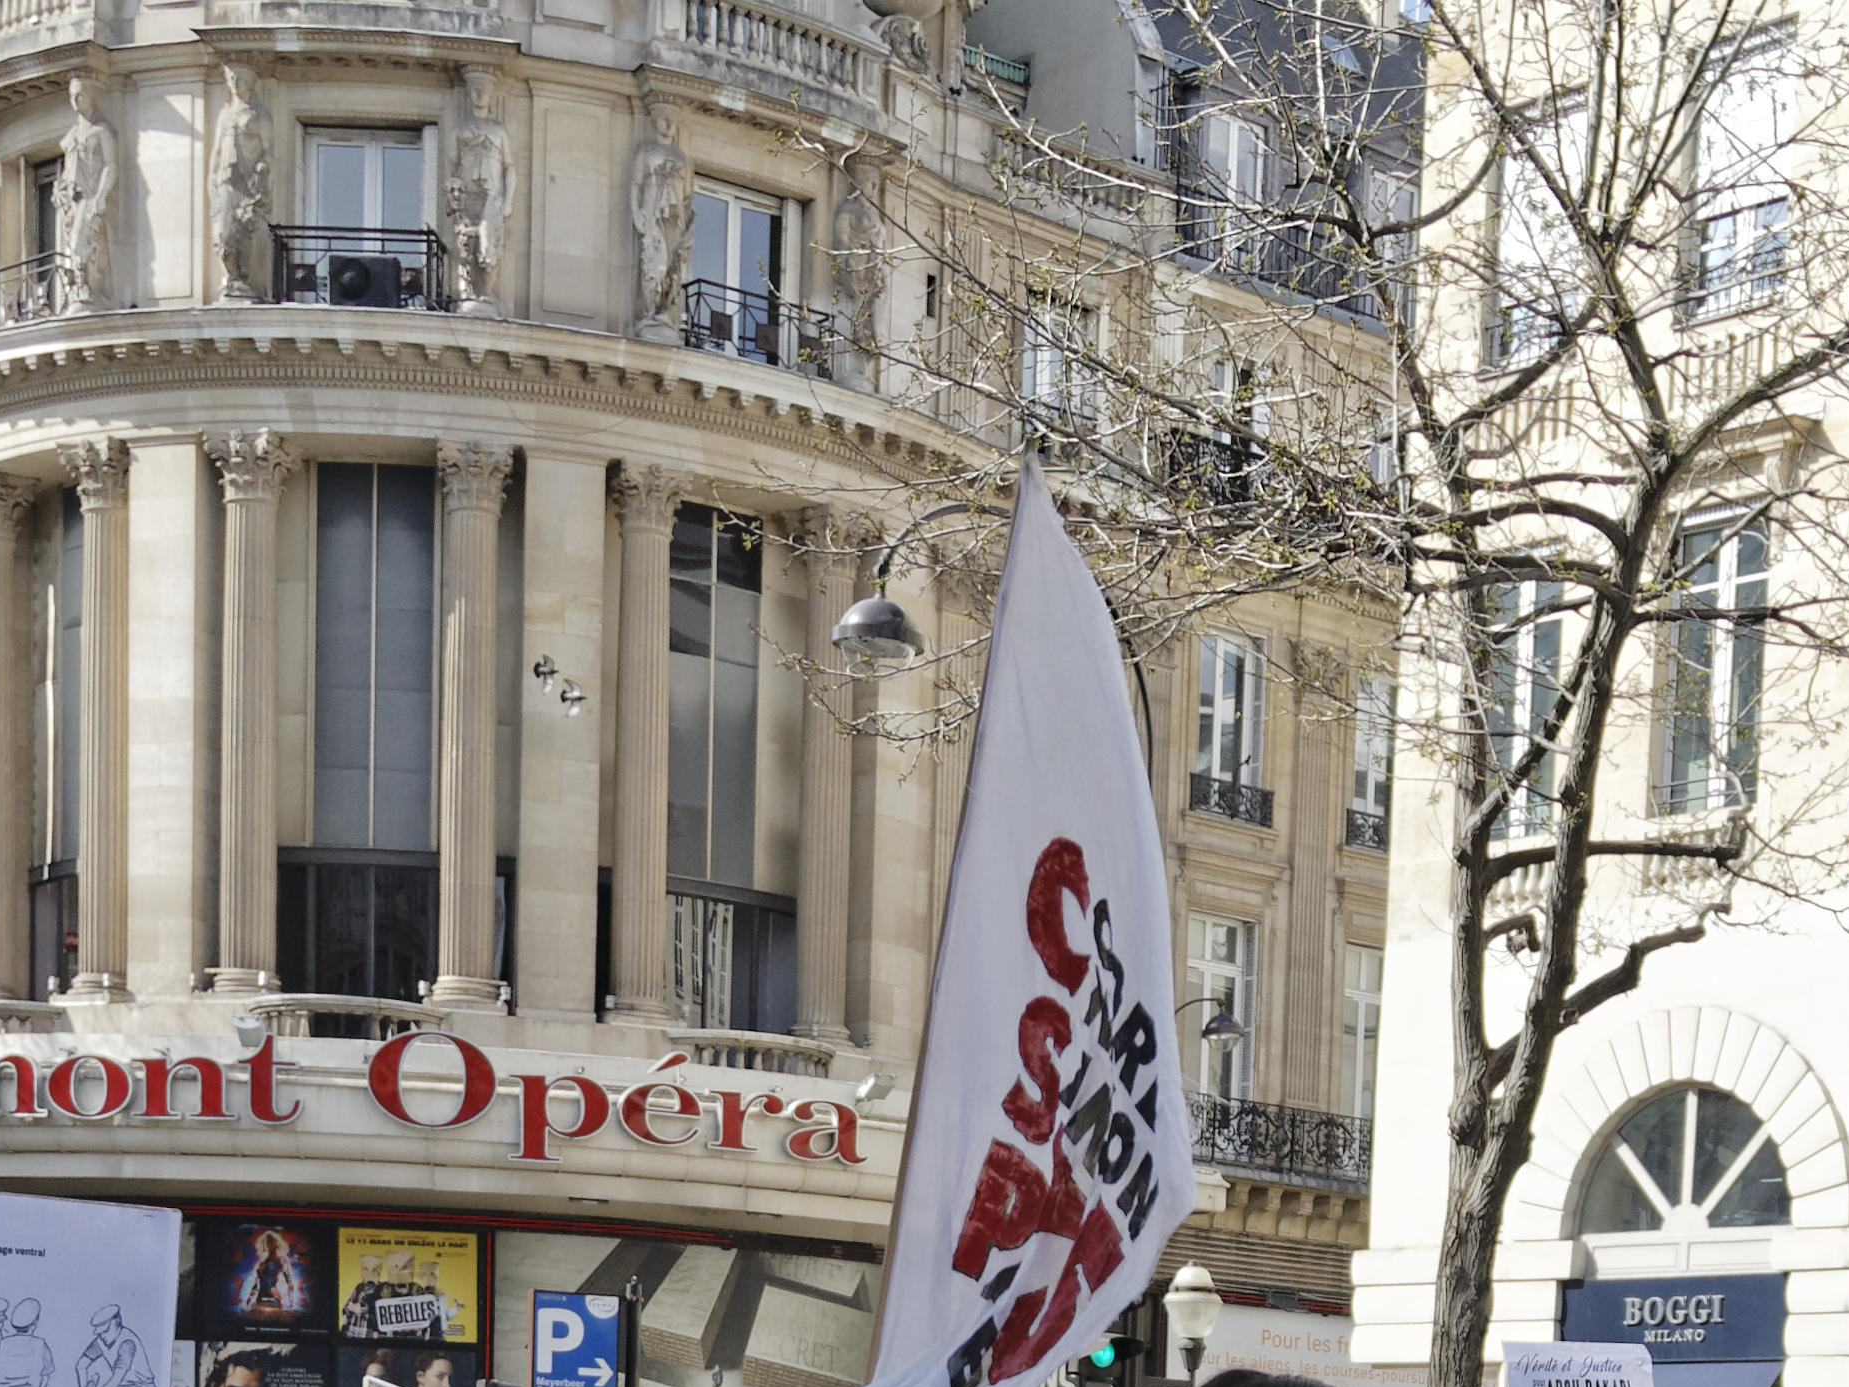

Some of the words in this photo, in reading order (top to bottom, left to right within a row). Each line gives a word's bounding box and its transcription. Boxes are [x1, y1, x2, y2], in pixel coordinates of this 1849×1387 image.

[365, 1028, 868, 1165] Opéra
[15, 1246, 47, 1257] ventral
[378, 1301, 436, 1326] REBELLES
[1622, 1294, 1726, 1327] BOGGI
[537, 1307, 585, 1374] P
[1261, 1329, 1301, 1351] Pour
[1306, 1330, 1332, 1353] les
[1643, 1328, 1706, 1343] MILANO
[1225, 1352, 1246, 1368] les
[1299, 1358, 1319, 1375] les
[1514, 1353, 1559, 1375] Vérité
[1561, 1356, 1574, 1373] et
[1579, 1354, 1624, 1378] Justice
